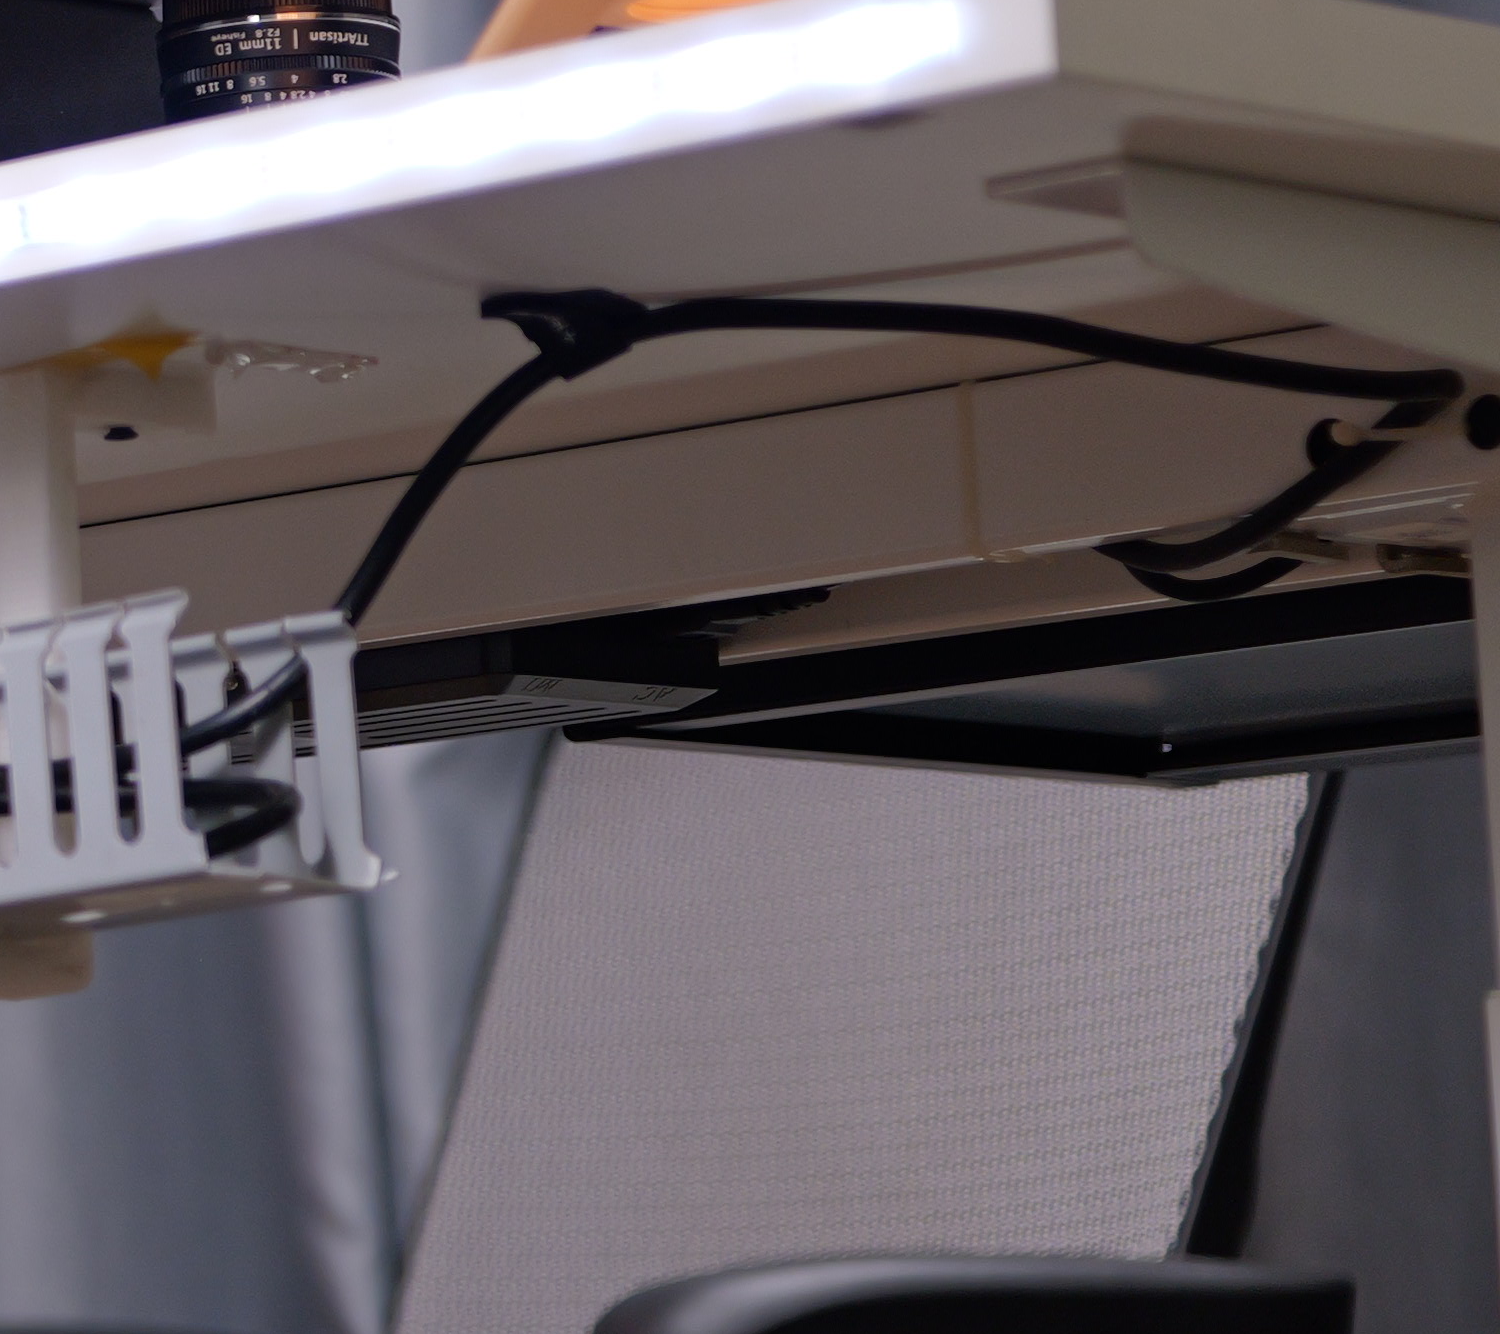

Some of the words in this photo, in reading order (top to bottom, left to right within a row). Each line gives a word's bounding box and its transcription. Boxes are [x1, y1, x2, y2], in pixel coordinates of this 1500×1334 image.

[211, 30, 246, 42] Fisheye
[254, 27, 281, 38] F2.8
[309, 30, 370, 46] TTArtisan
[214, 42, 232, 56] ED
[239, 37, 281, 51] 11mm
[248, 76, 267, 87] 5.6
[291, 74, 300, 84] 4
[333, 73, 348, 84] 2.8
[208, 81, 220, 93] 11
[226, 79, 234, 90] 8
[195, 85, 207, 96] 16
[241, 93, 253, 104] 16
[264, 91, 272, 102] 8
